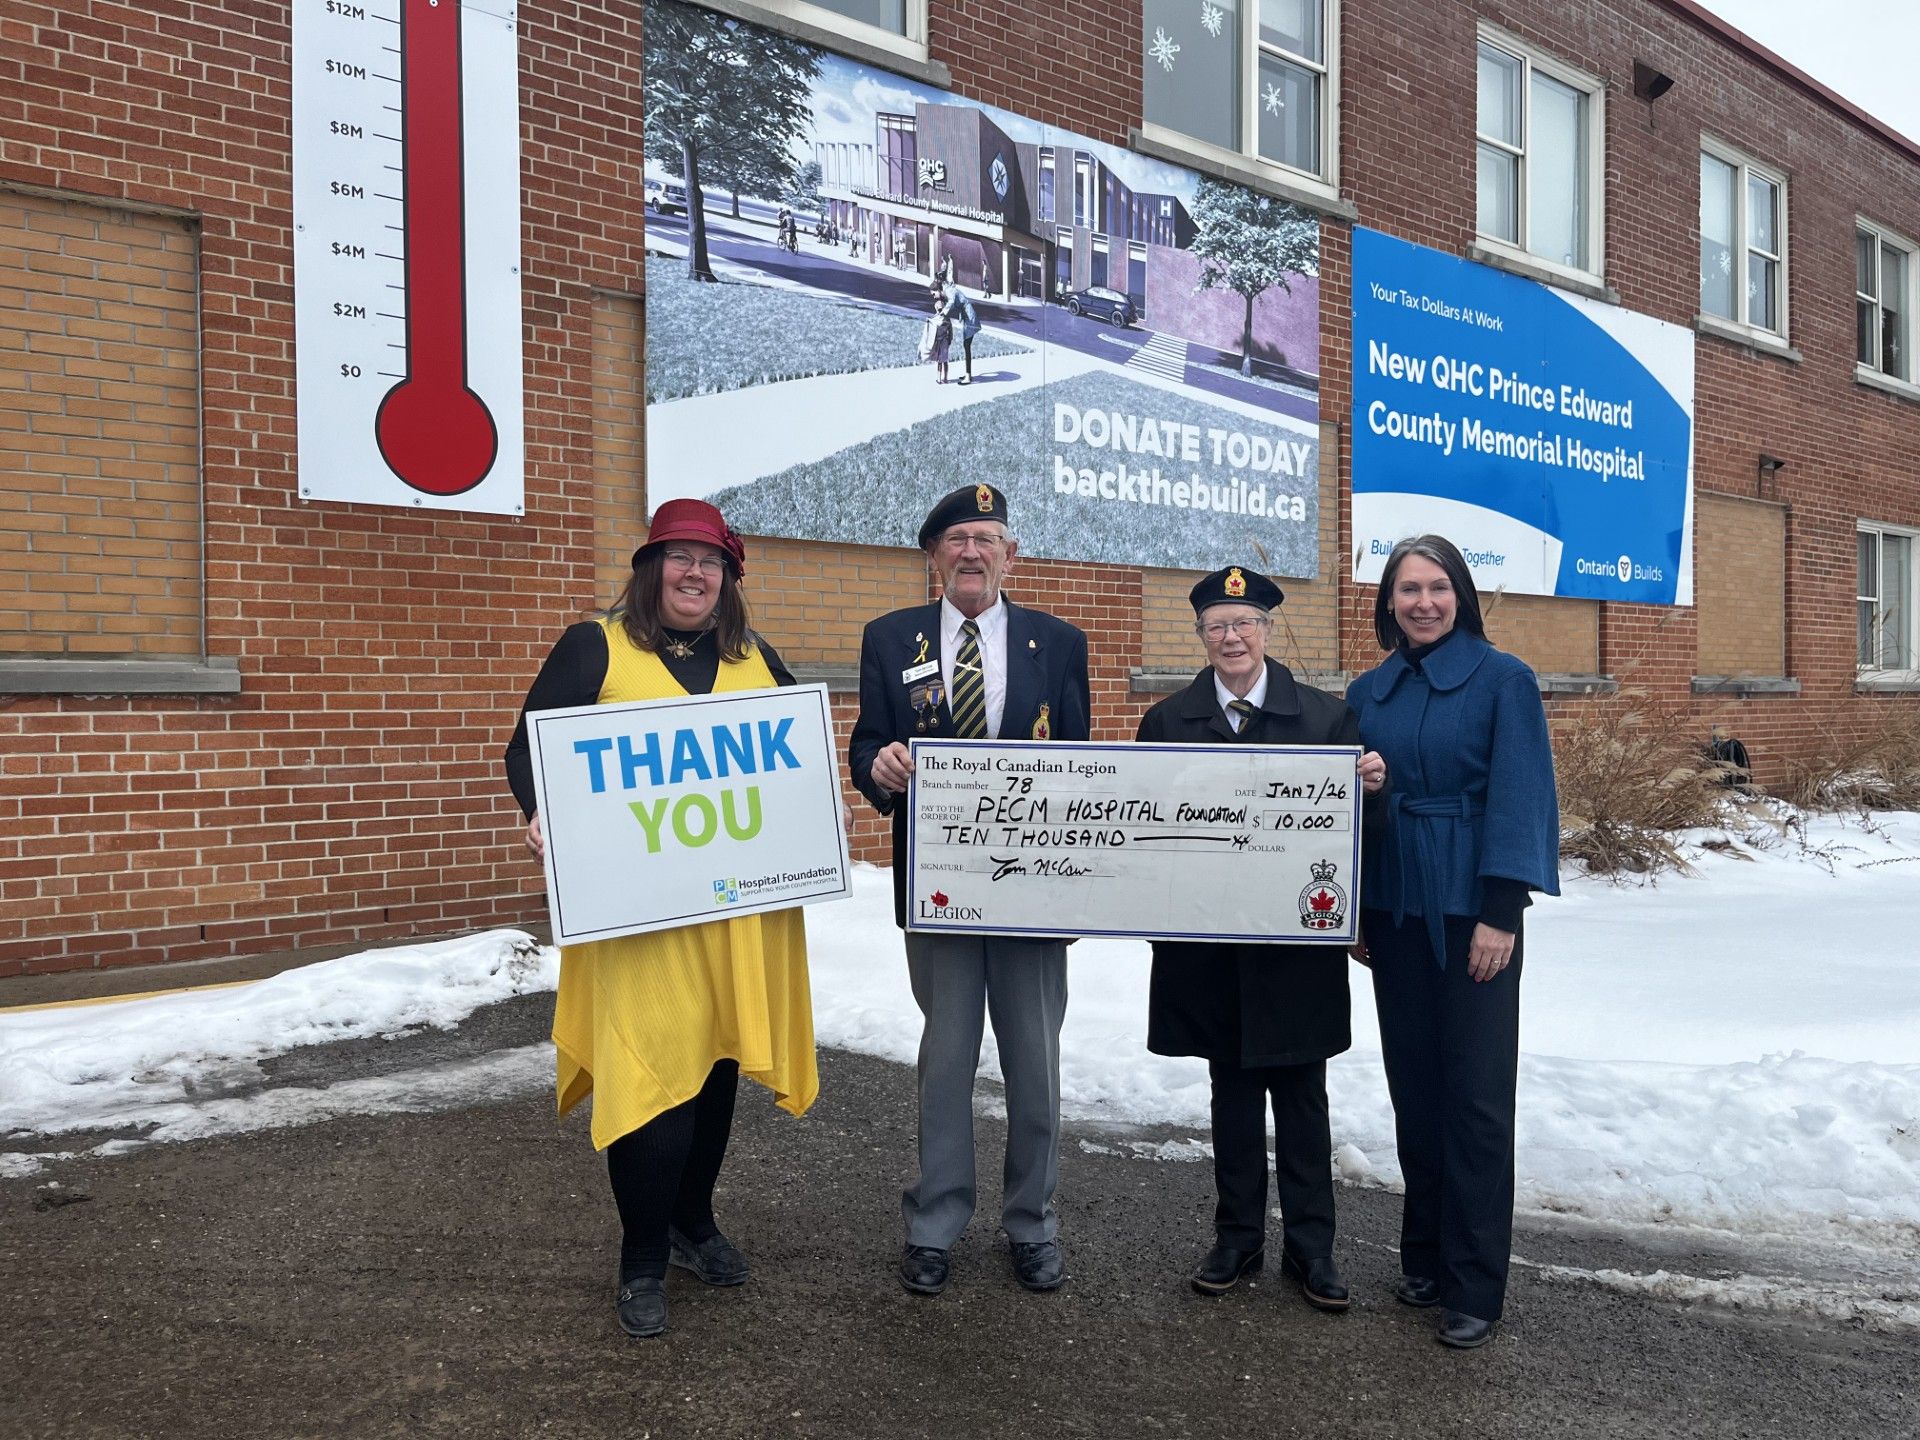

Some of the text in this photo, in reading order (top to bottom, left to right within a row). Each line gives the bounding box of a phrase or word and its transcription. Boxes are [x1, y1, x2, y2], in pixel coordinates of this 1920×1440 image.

[326, 0, 364, 20] $12M
[326, 59, 366, 80] $10M
[331, 120, 363, 139] $8M
[919, 158, 944, 173] QHC
[331, 181, 364, 199] $6M
[931, 200, 967, 217] Memorial
[969, 206, 1004, 227] Hospital
[1161, 200, 1171, 216] H
[331, 242, 365, 259] $4M
[333, 302, 366, 319] $2M
[1370, 281, 1503, 332] Your Tax Dollars At Work
[340, 363, 361, 378] $0
[1369, 339, 1632, 429] New QHC Prince Edward
[1055, 403, 1311, 477] DONATE TODAY
[1368, 400, 1645, 482] County Memorial Hospital
[1055, 456, 1305, 521] backthebuild.ca
[1462, 548, 1505, 568] Together
[1577, 558, 1662, 581] Ontario Builds
[574, 718, 801, 793] THANK
[922, 757, 1117, 778] The Royal Canadian Legion
[921, 780, 989, 790] Branch number
[1005, 776, 1034, 794] 78
[1235, 789, 1257, 797] DATE
[921, 805, 965, 813] PAY TO THE
[921, 812, 961, 821] ORDER OF
[975, 796, 1248, 824] PECM HOSPITAL FOUNDATION
[627, 786, 762, 853] YOU
[1252, 817, 1260, 828] $
[1275, 813, 1334, 830] 10,000
[942, 825, 989, 845] TEN
[1002, 827, 1125, 848] THOUSAND
[1248, 844, 1285, 852] DOLLARS
[920, 863, 964, 872] SIGNATURE
[739, 866, 837, 889] Hospital Foundation
[741, 878, 838, 897] SUPPORTING YOUR COUNTY HOSPITAL
[920, 900, 982, 920] LEGION
[1305, 911, 1340, 921] LEGION
